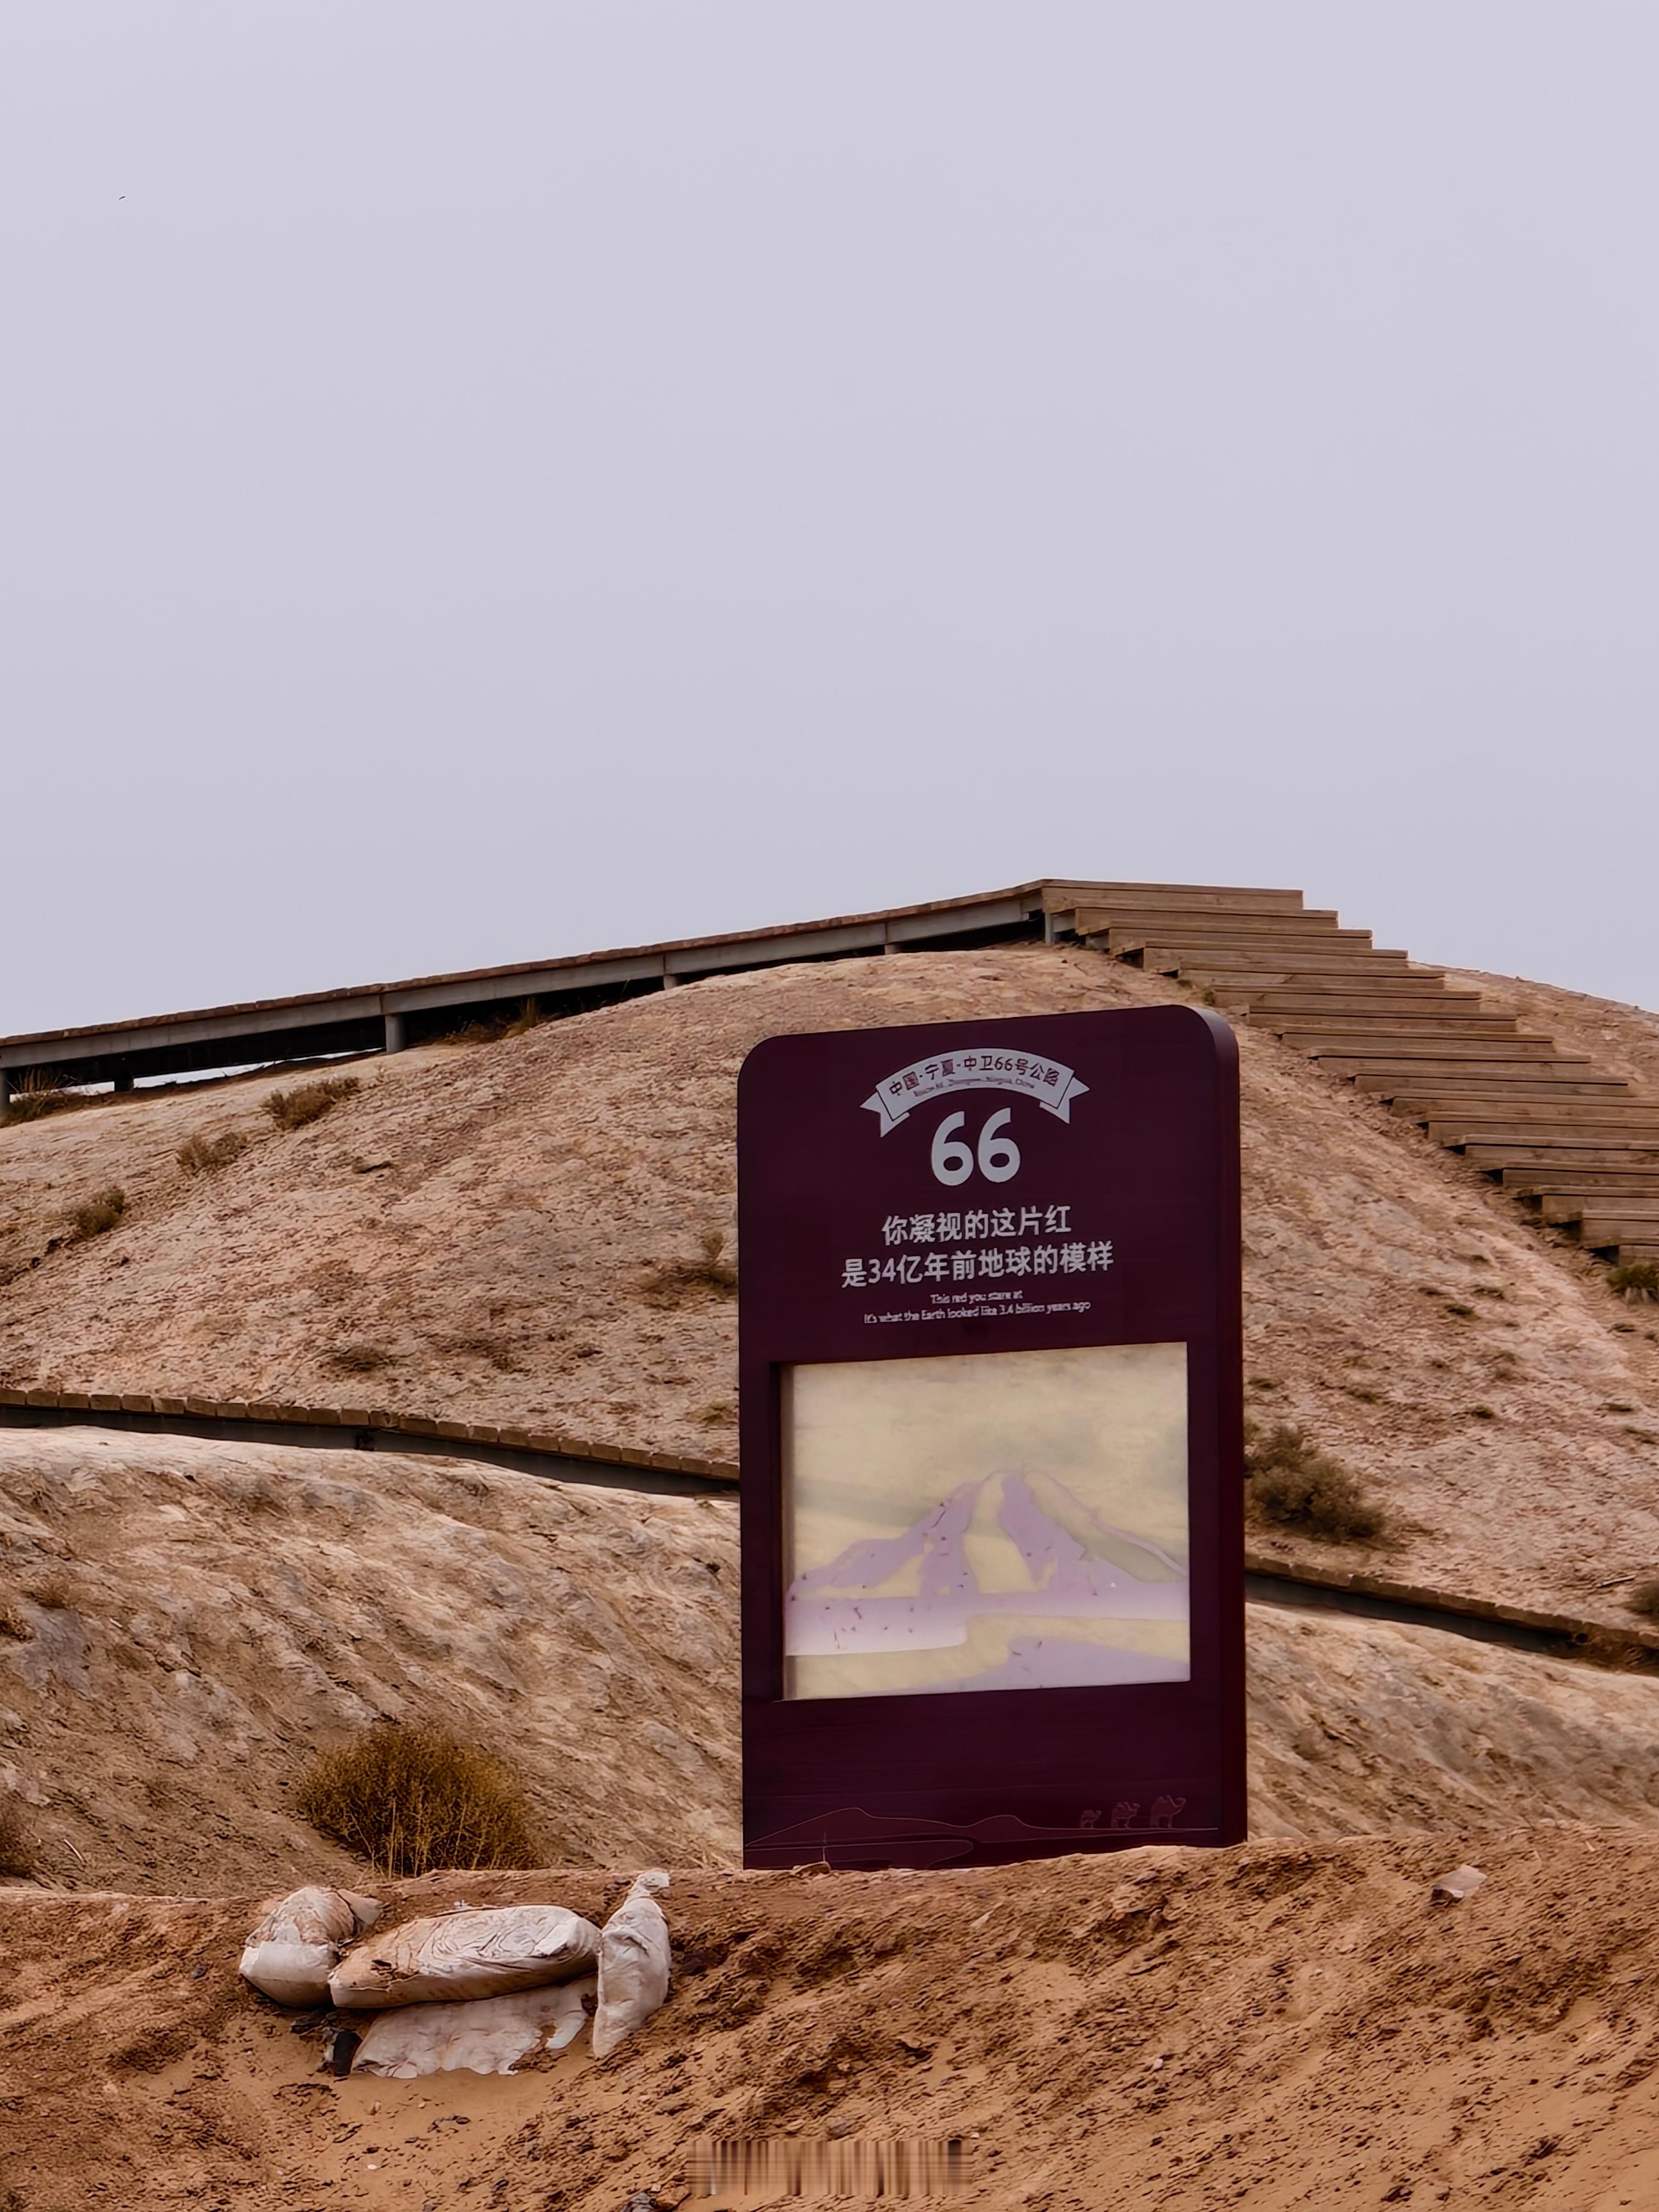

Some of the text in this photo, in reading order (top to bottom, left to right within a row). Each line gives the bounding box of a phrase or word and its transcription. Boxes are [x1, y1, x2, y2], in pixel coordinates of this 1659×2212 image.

[931, 1107, 1021, 1186] 66
[882, 1205, 1071, 1245] 你凝视的这片红
[841, 1241, 1114, 1289] 是34亿年前地球的模样
[903, 1310, 920, 1321] the
[921, 1309, 945, 1320] Earth
[947, 1306, 979, 1318] looked
[999, 1304, 1014, 1315] 3.4
[1015, 1303, 1045, 1314] billion
[1046, 1303, 1071, 1314] years
[1072, 1301, 1091, 1313] ago
[930, 1294, 950, 1304] This
[968, 1294, 987, 1304] you
